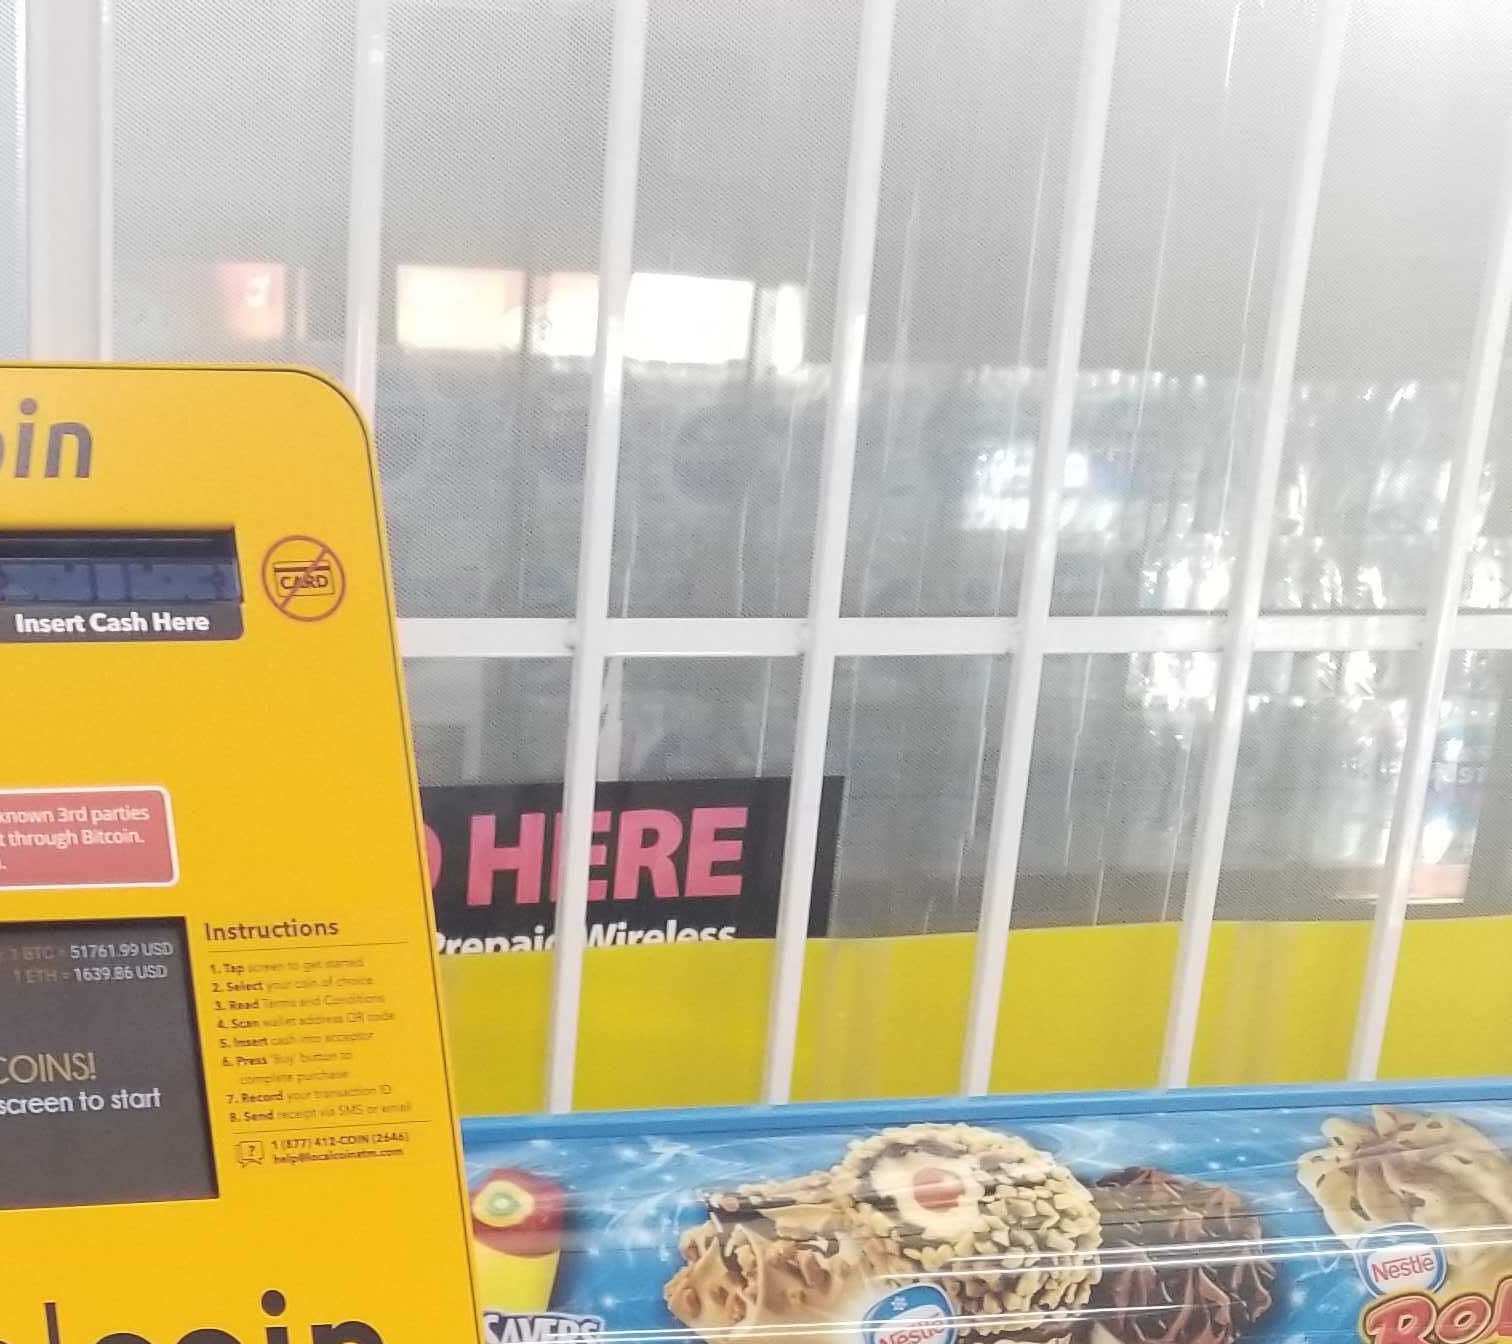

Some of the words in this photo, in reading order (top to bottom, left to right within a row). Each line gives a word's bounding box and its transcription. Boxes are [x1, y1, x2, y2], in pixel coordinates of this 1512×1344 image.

[279, 574, 329, 590] CARD
[14, 612, 85, 633] Insert
[89, 611, 148, 632] Cash
[152, 611, 210, 631] Here
[57, 806, 87, 823] 3rd
[91, 805, 150, 824] parties
[7, 829, 78, 850] through
[82, 828, 144, 846] Bitcoin.
[466, 805, 749, 907] HERE
[204, 918, 339, 941] Instructions
[140, 942, 174, 957] USD
[135, 964, 168, 979] USD
[226, 981, 264, 992] Select
[78, 1090, 104, 1112] to
[109, 1087, 161, 1110] start
